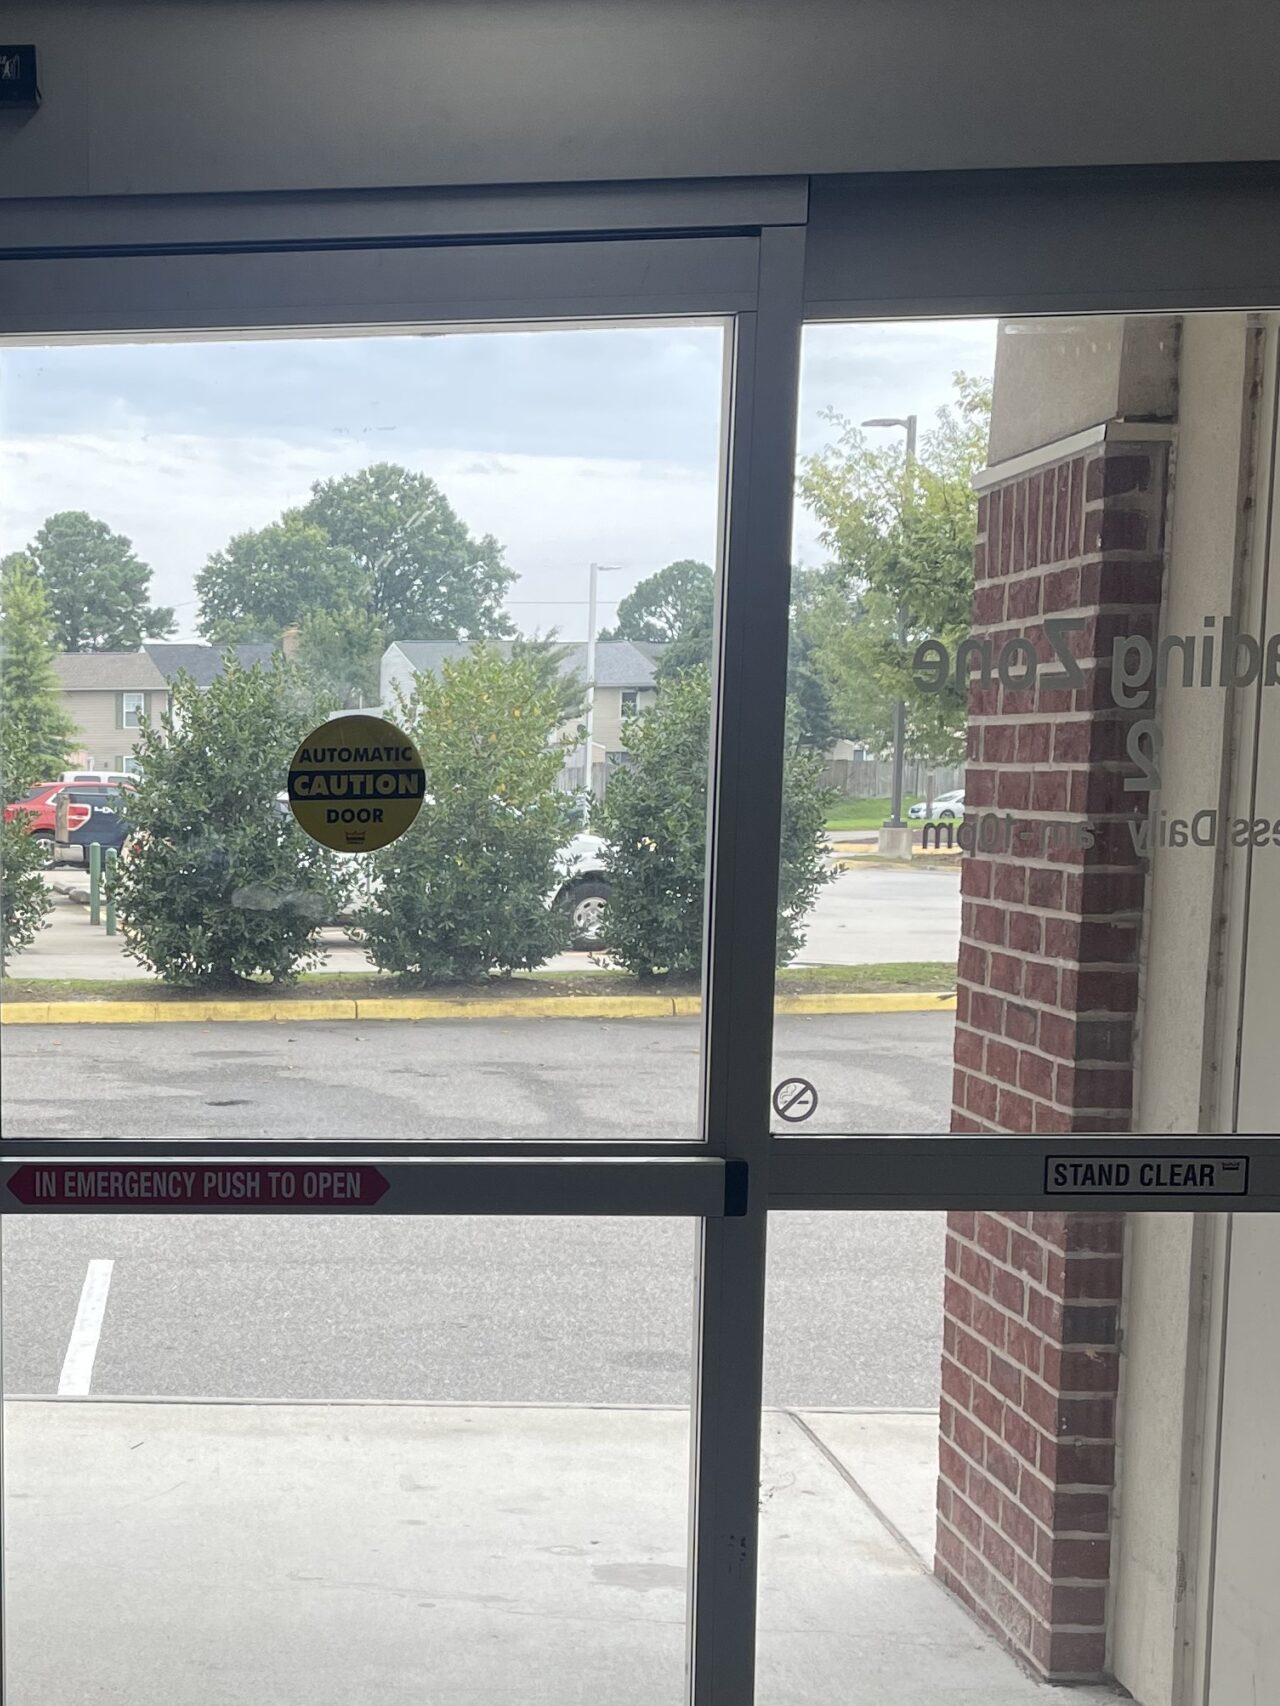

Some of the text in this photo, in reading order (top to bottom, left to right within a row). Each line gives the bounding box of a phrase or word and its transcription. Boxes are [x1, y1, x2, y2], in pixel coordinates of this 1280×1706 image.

[299, 747, 413, 763] AUTOMATIC
[293, 774, 419, 796] CAUTION
[326, 808, 384, 823] DOOR
[35, 1171, 362, 1199] IN EMERGENCY PUSH TO OPEN
[1054, 1163, 1215, 1187] STAND CLEAR
